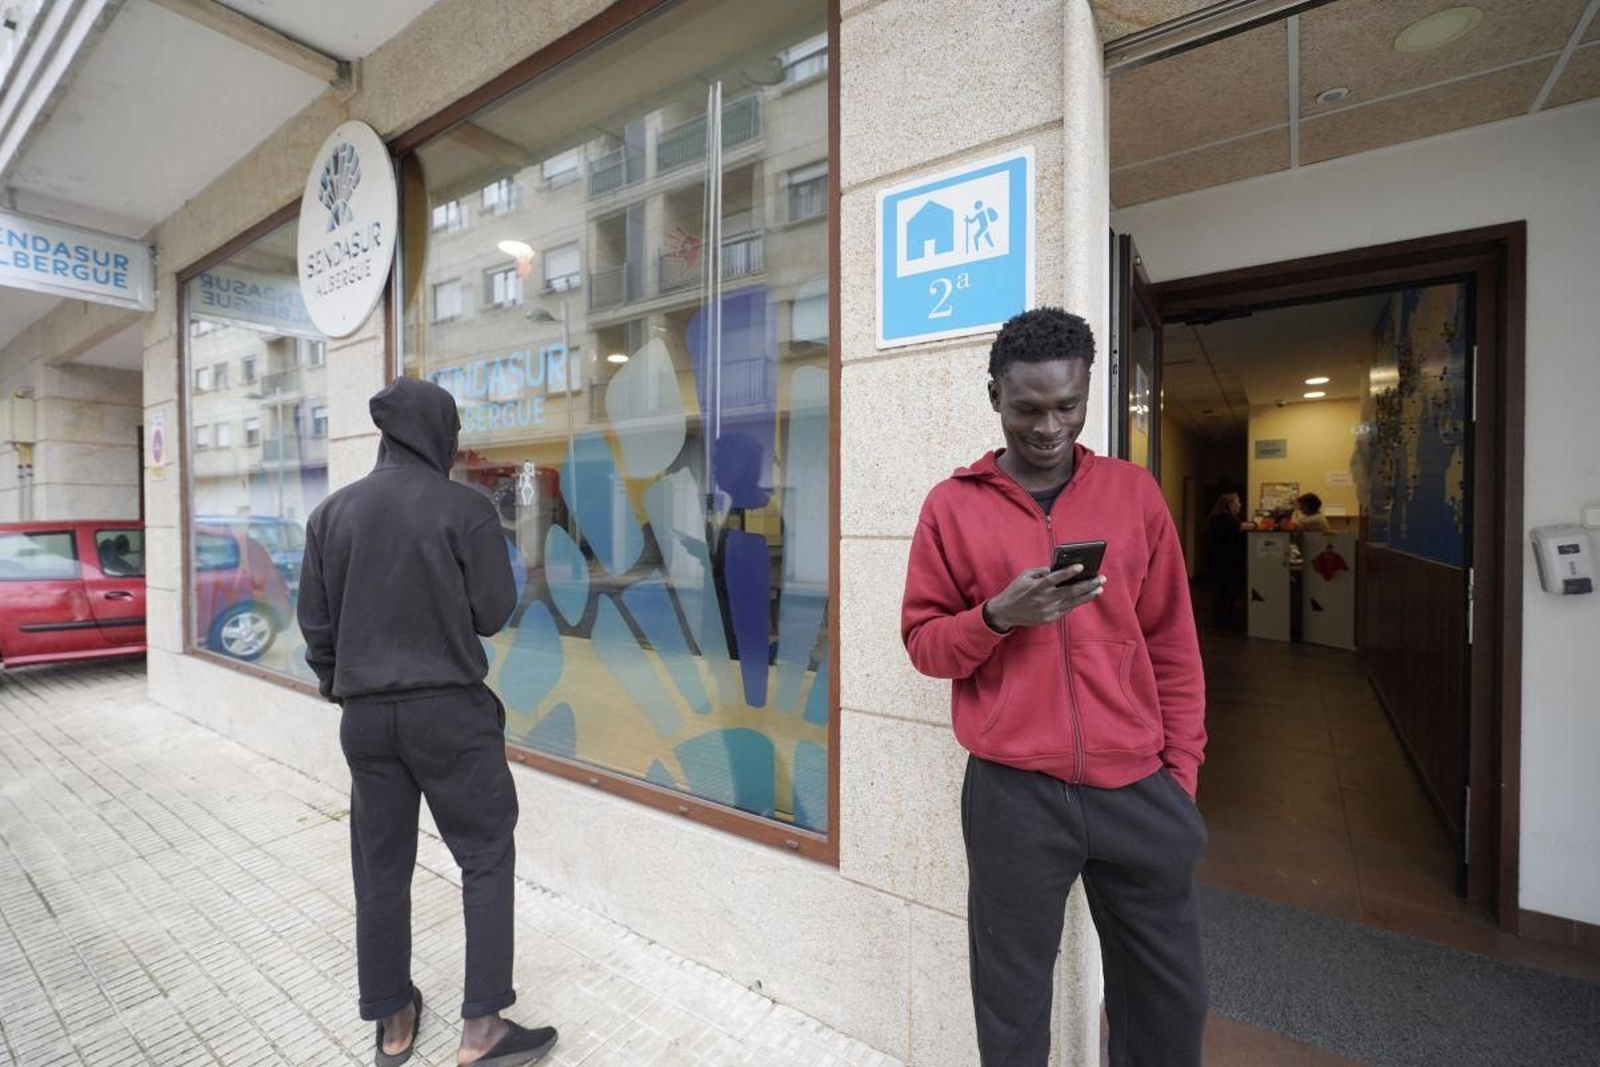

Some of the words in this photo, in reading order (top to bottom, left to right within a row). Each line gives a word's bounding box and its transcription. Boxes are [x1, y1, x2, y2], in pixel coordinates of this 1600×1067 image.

[0, 227, 129, 271] NDASUR
[307, 221, 381, 279] SENDASUR
[315, 258, 371, 298] ALBERGUE
[461, 396, 547, 435] BERGUE
